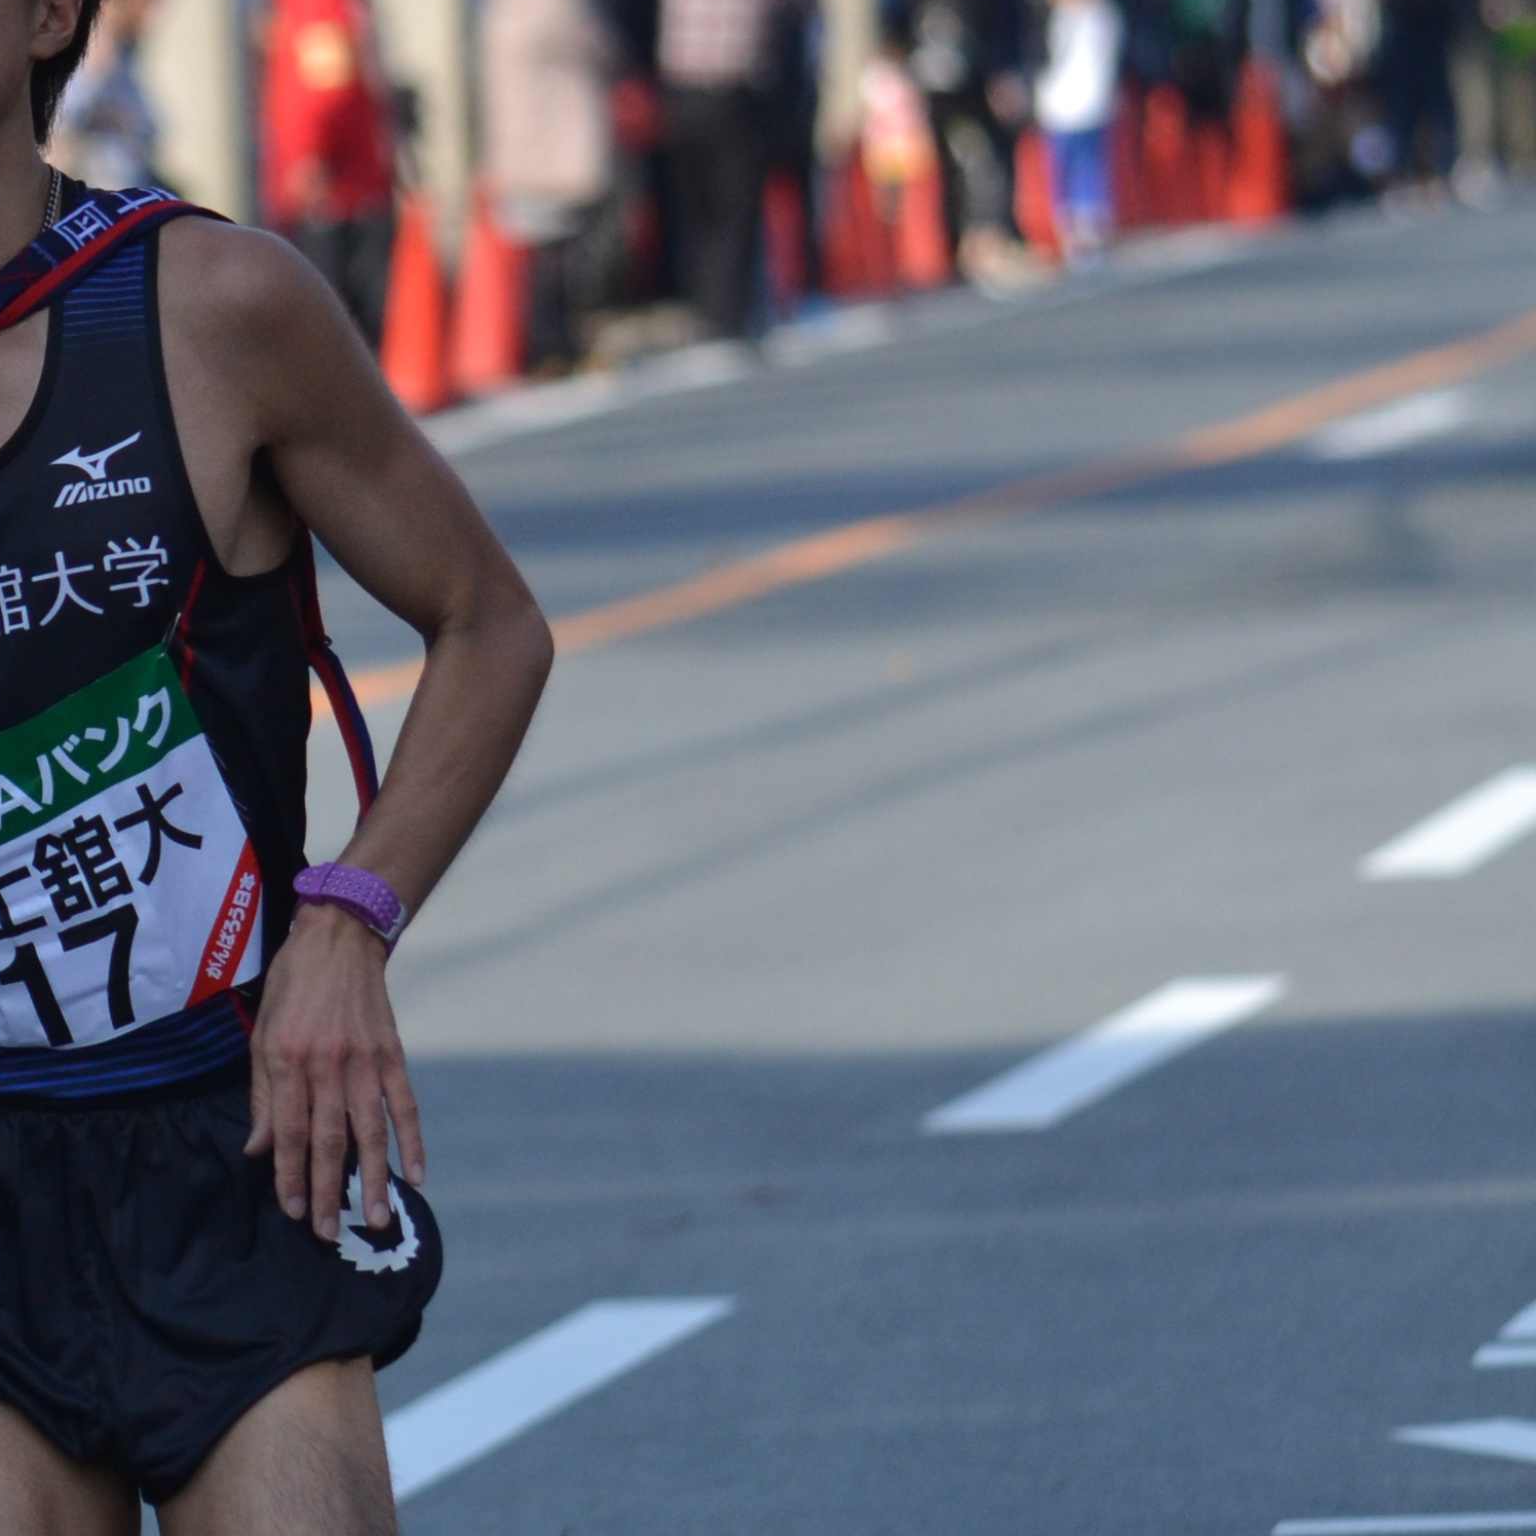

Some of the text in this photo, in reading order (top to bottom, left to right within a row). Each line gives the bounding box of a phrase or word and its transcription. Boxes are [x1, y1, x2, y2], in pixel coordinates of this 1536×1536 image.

[54, 476, 152, 508] MIZUNO
[205, 871, 257, 981] がんばろう日本
